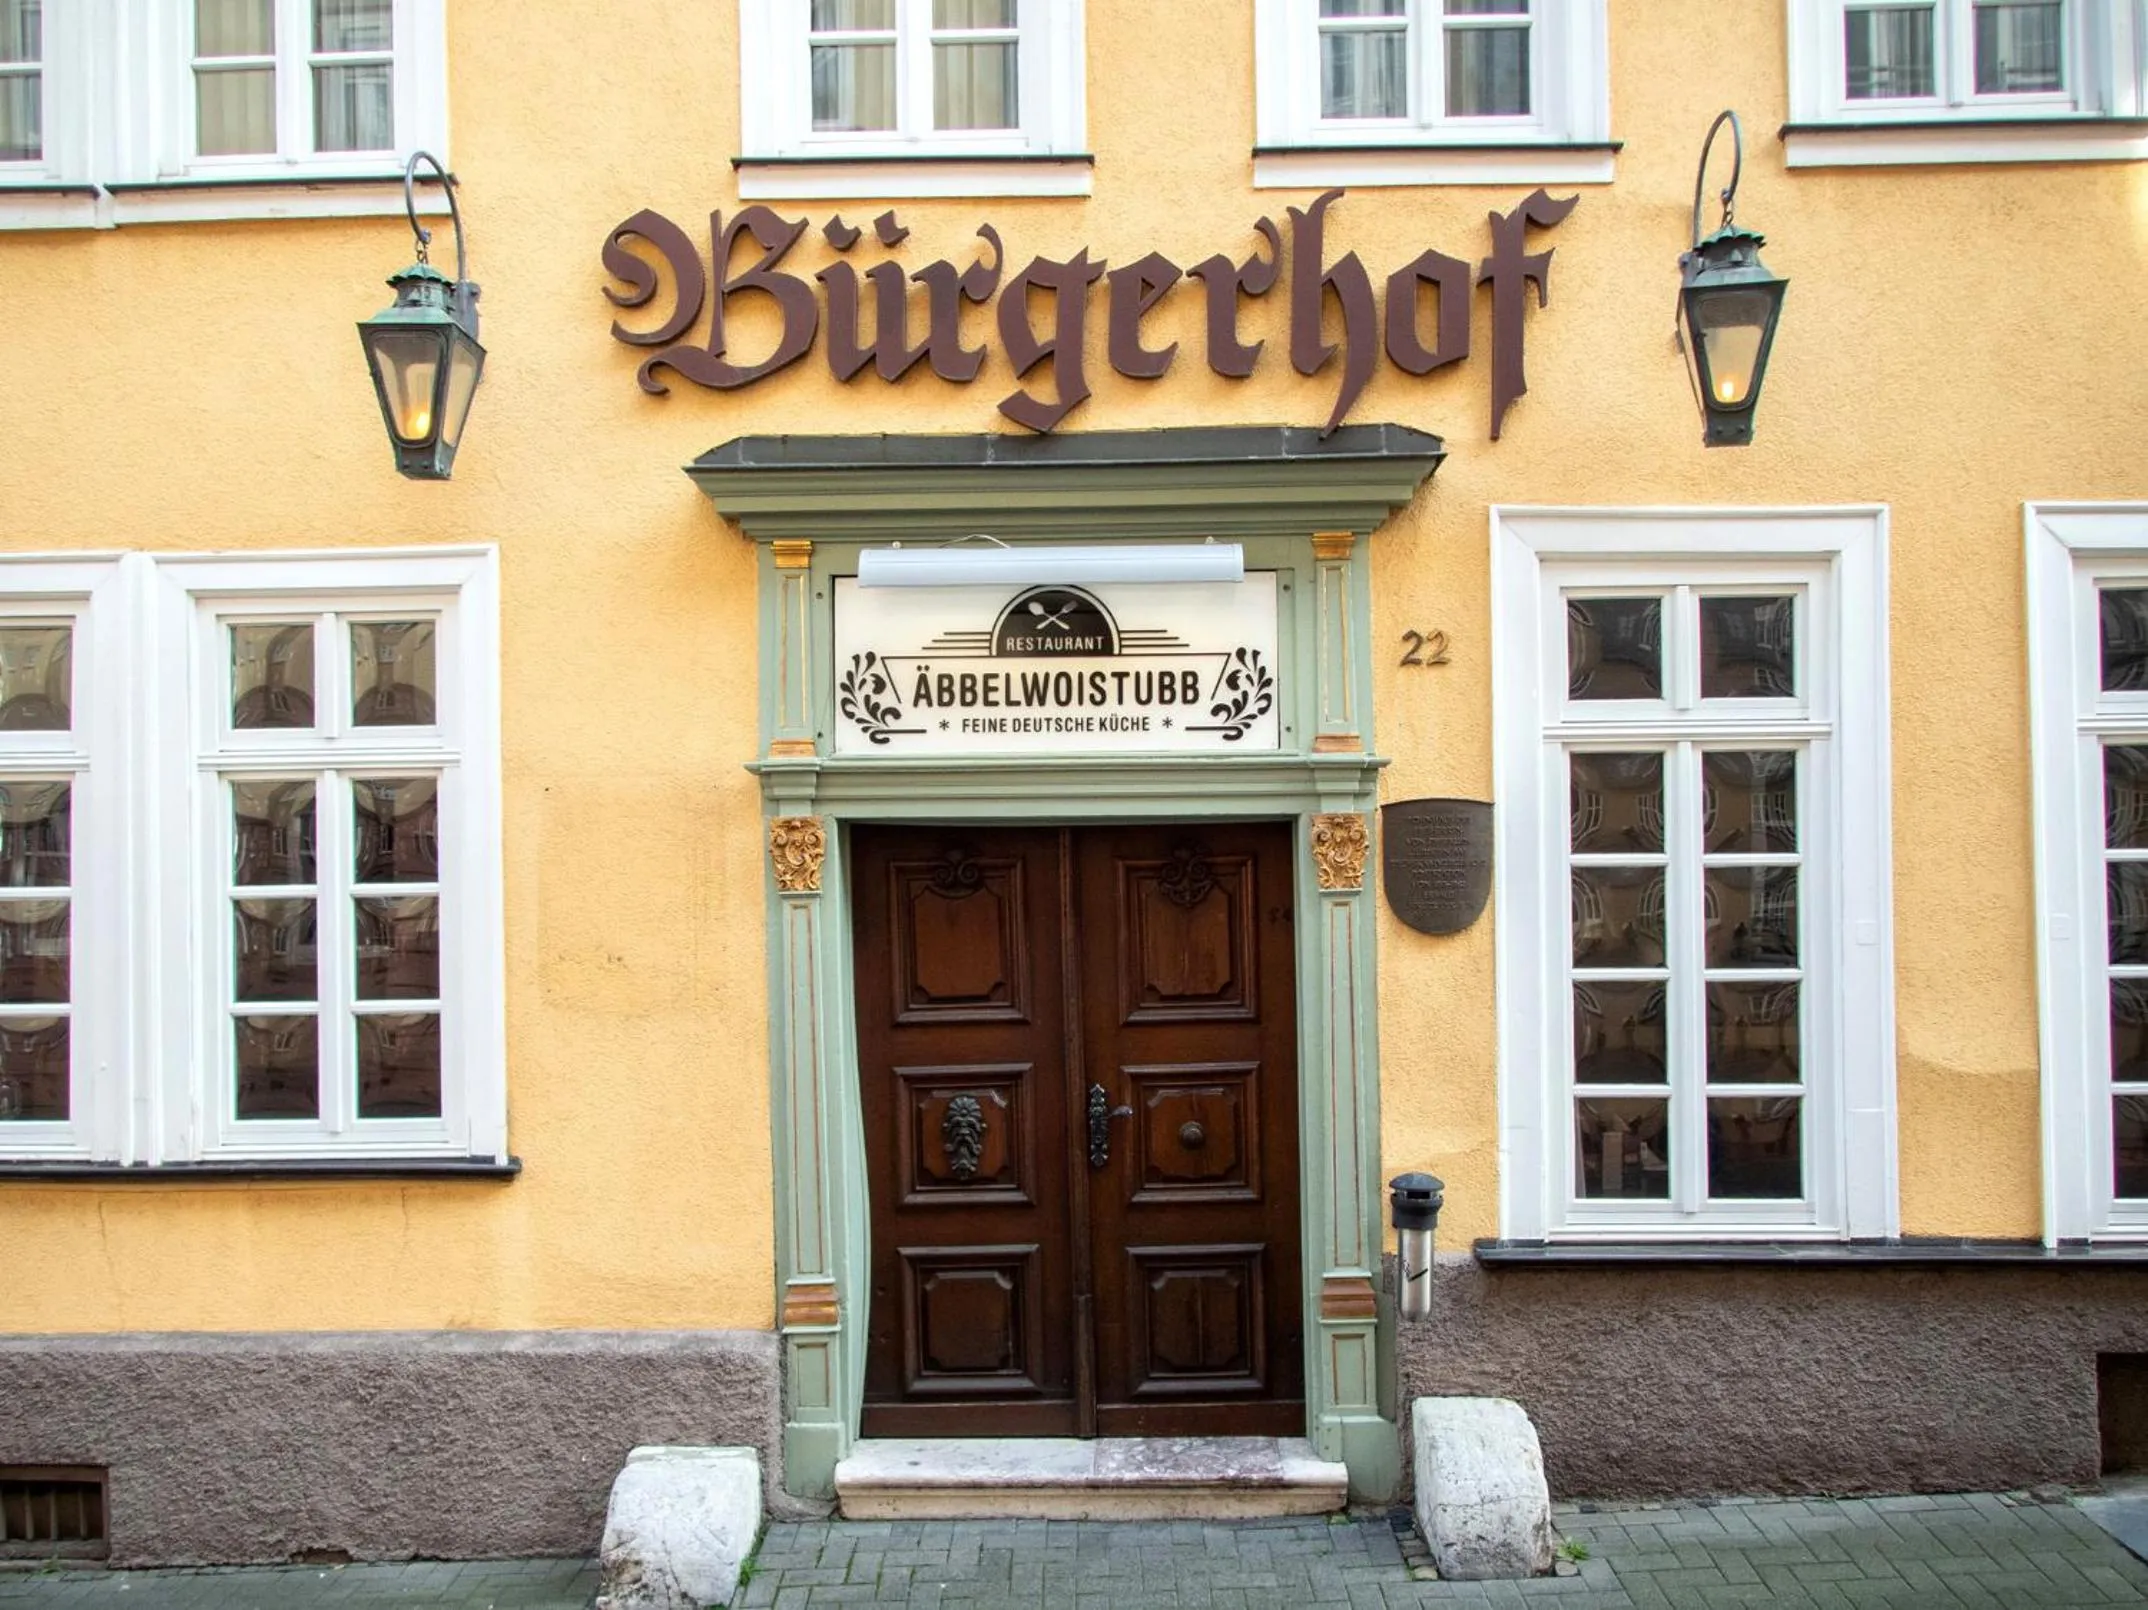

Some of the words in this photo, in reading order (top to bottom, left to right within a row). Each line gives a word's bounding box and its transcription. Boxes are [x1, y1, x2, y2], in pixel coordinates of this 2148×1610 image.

[601, 189, 1580, 441] Bürgerhof
[1006, 636, 1104, 651] RESTAURANT
[1400, 629, 1452, 667] 22
[913, 665, 1200, 708] ÄBBELWOISTUBB
[961, 718, 1007, 733] FEINE
[1012, 717, 1095, 733] DEUTSCHE
[1099, 714, 1150, 732] KÜCHE
